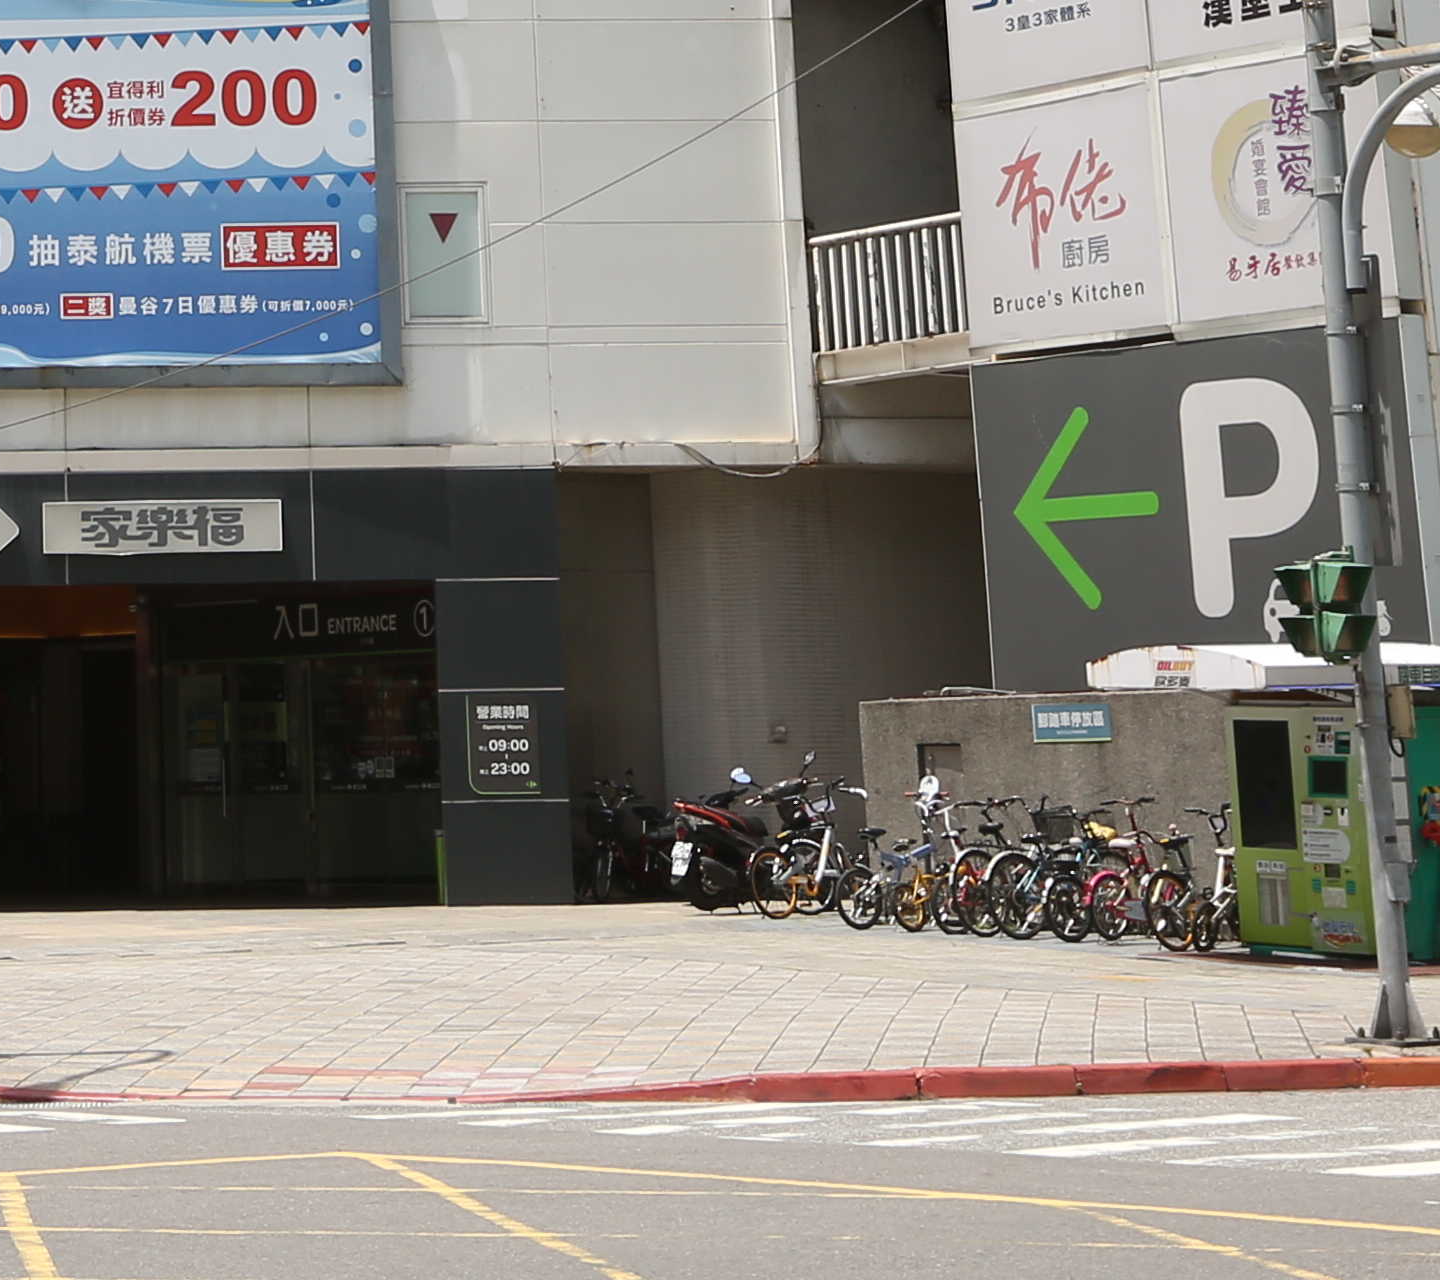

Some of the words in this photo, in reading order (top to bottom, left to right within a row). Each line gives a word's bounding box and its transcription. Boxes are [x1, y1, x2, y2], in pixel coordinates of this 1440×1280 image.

[1004, 2, 1092, 32] 3皇3家體系
[107, 80, 165, 99] 宜得利
[170, 69, 317, 127] 200
[107, 107, 166, 127] 折價券
[1251, 138, 1271, 217] 婚宴會館
[28, 231, 213, 267] 抽泰航機票
[227, 229, 334, 264] 優惠券
[1061, 234, 1110, 269] 廚房
[67, 297, 107, 316] 二獎
[119, 295, 259, 315] 曼谷7日優惠券
[993, 289, 1063, 315] Bruce's
[1072, 280, 1145, 305] Kitchen
[1180, 378, 1319, 618] P
[80, 506, 244, 548] 家樂福
[273, 603, 319, 640] 入口
[327, 614, 398, 634] ENTRANCE
[476, 705, 529, 719] 營業時間
[488, 739, 529, 752] 09:00
[490, 762, 530, 775] 23:00
